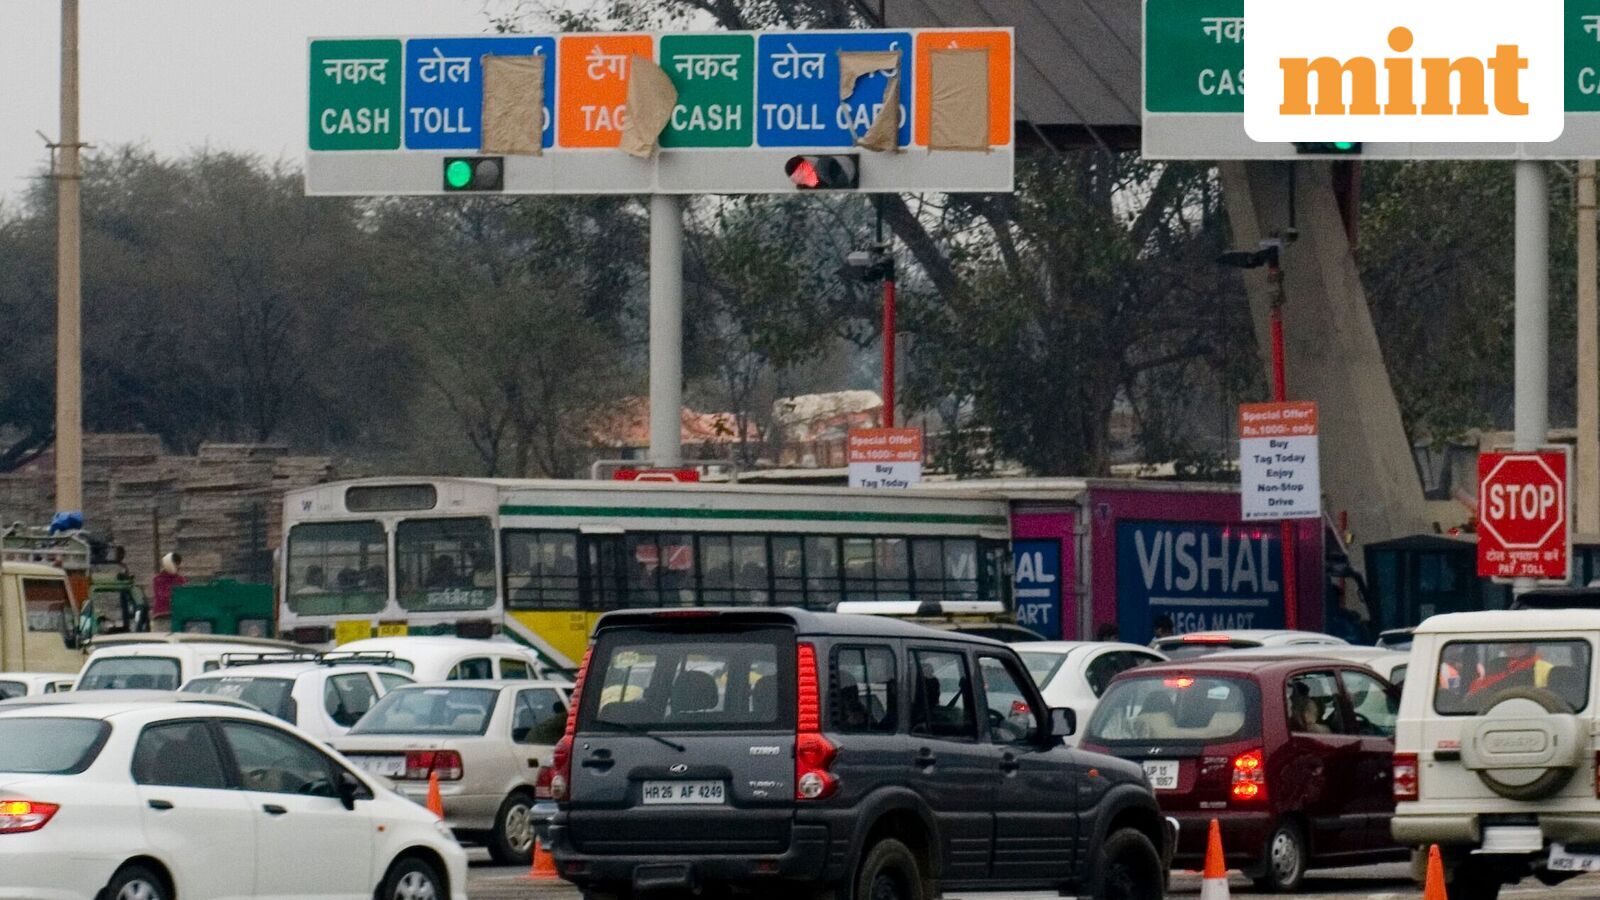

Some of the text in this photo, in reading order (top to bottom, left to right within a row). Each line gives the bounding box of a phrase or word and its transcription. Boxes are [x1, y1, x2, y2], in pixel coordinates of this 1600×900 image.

[1200, 17, 1244, 43] नक
[322, 58, 390, 84] नकद
[418, 47, 472, 84] टोल
[585, 44, 627, 80] टैग
[673, 53, 742, 81] नकद
[771, 42, 826, 80] टोल
[1198, 68, 1244, 96] CA
[320, 107, 390, 134] CASH
[409, 107, 472, 133] TOLL
[581, 104, 627, 131] TAG
[671, 104, 742, 131] CASH
[762, 104, 826, 130] TOLL
[1242, 409, 1281, 422] Special
[1269, 439, 1289, 449] Buy
[875, 465, 894, 475] Buy
[1253, 453, 1306, 465] Tag Today
[861, 479, 909, 489] Tag Today
[1266, 469, 1294, 479] Enjoy
[1257, 483, 1305, 493] Non-Stop
[1268, 498, 1295, 507] Drive
[1489, 483, 1555, 520] STOP
[1134, 529, 1279, 593] VISHAL
[1498, 563, 1545, 575] PAY TOLL
[1016, 603, 1053, 625] ART
[681, 785, 695, 798] AF
[698, 785, 723, 799] 4249
